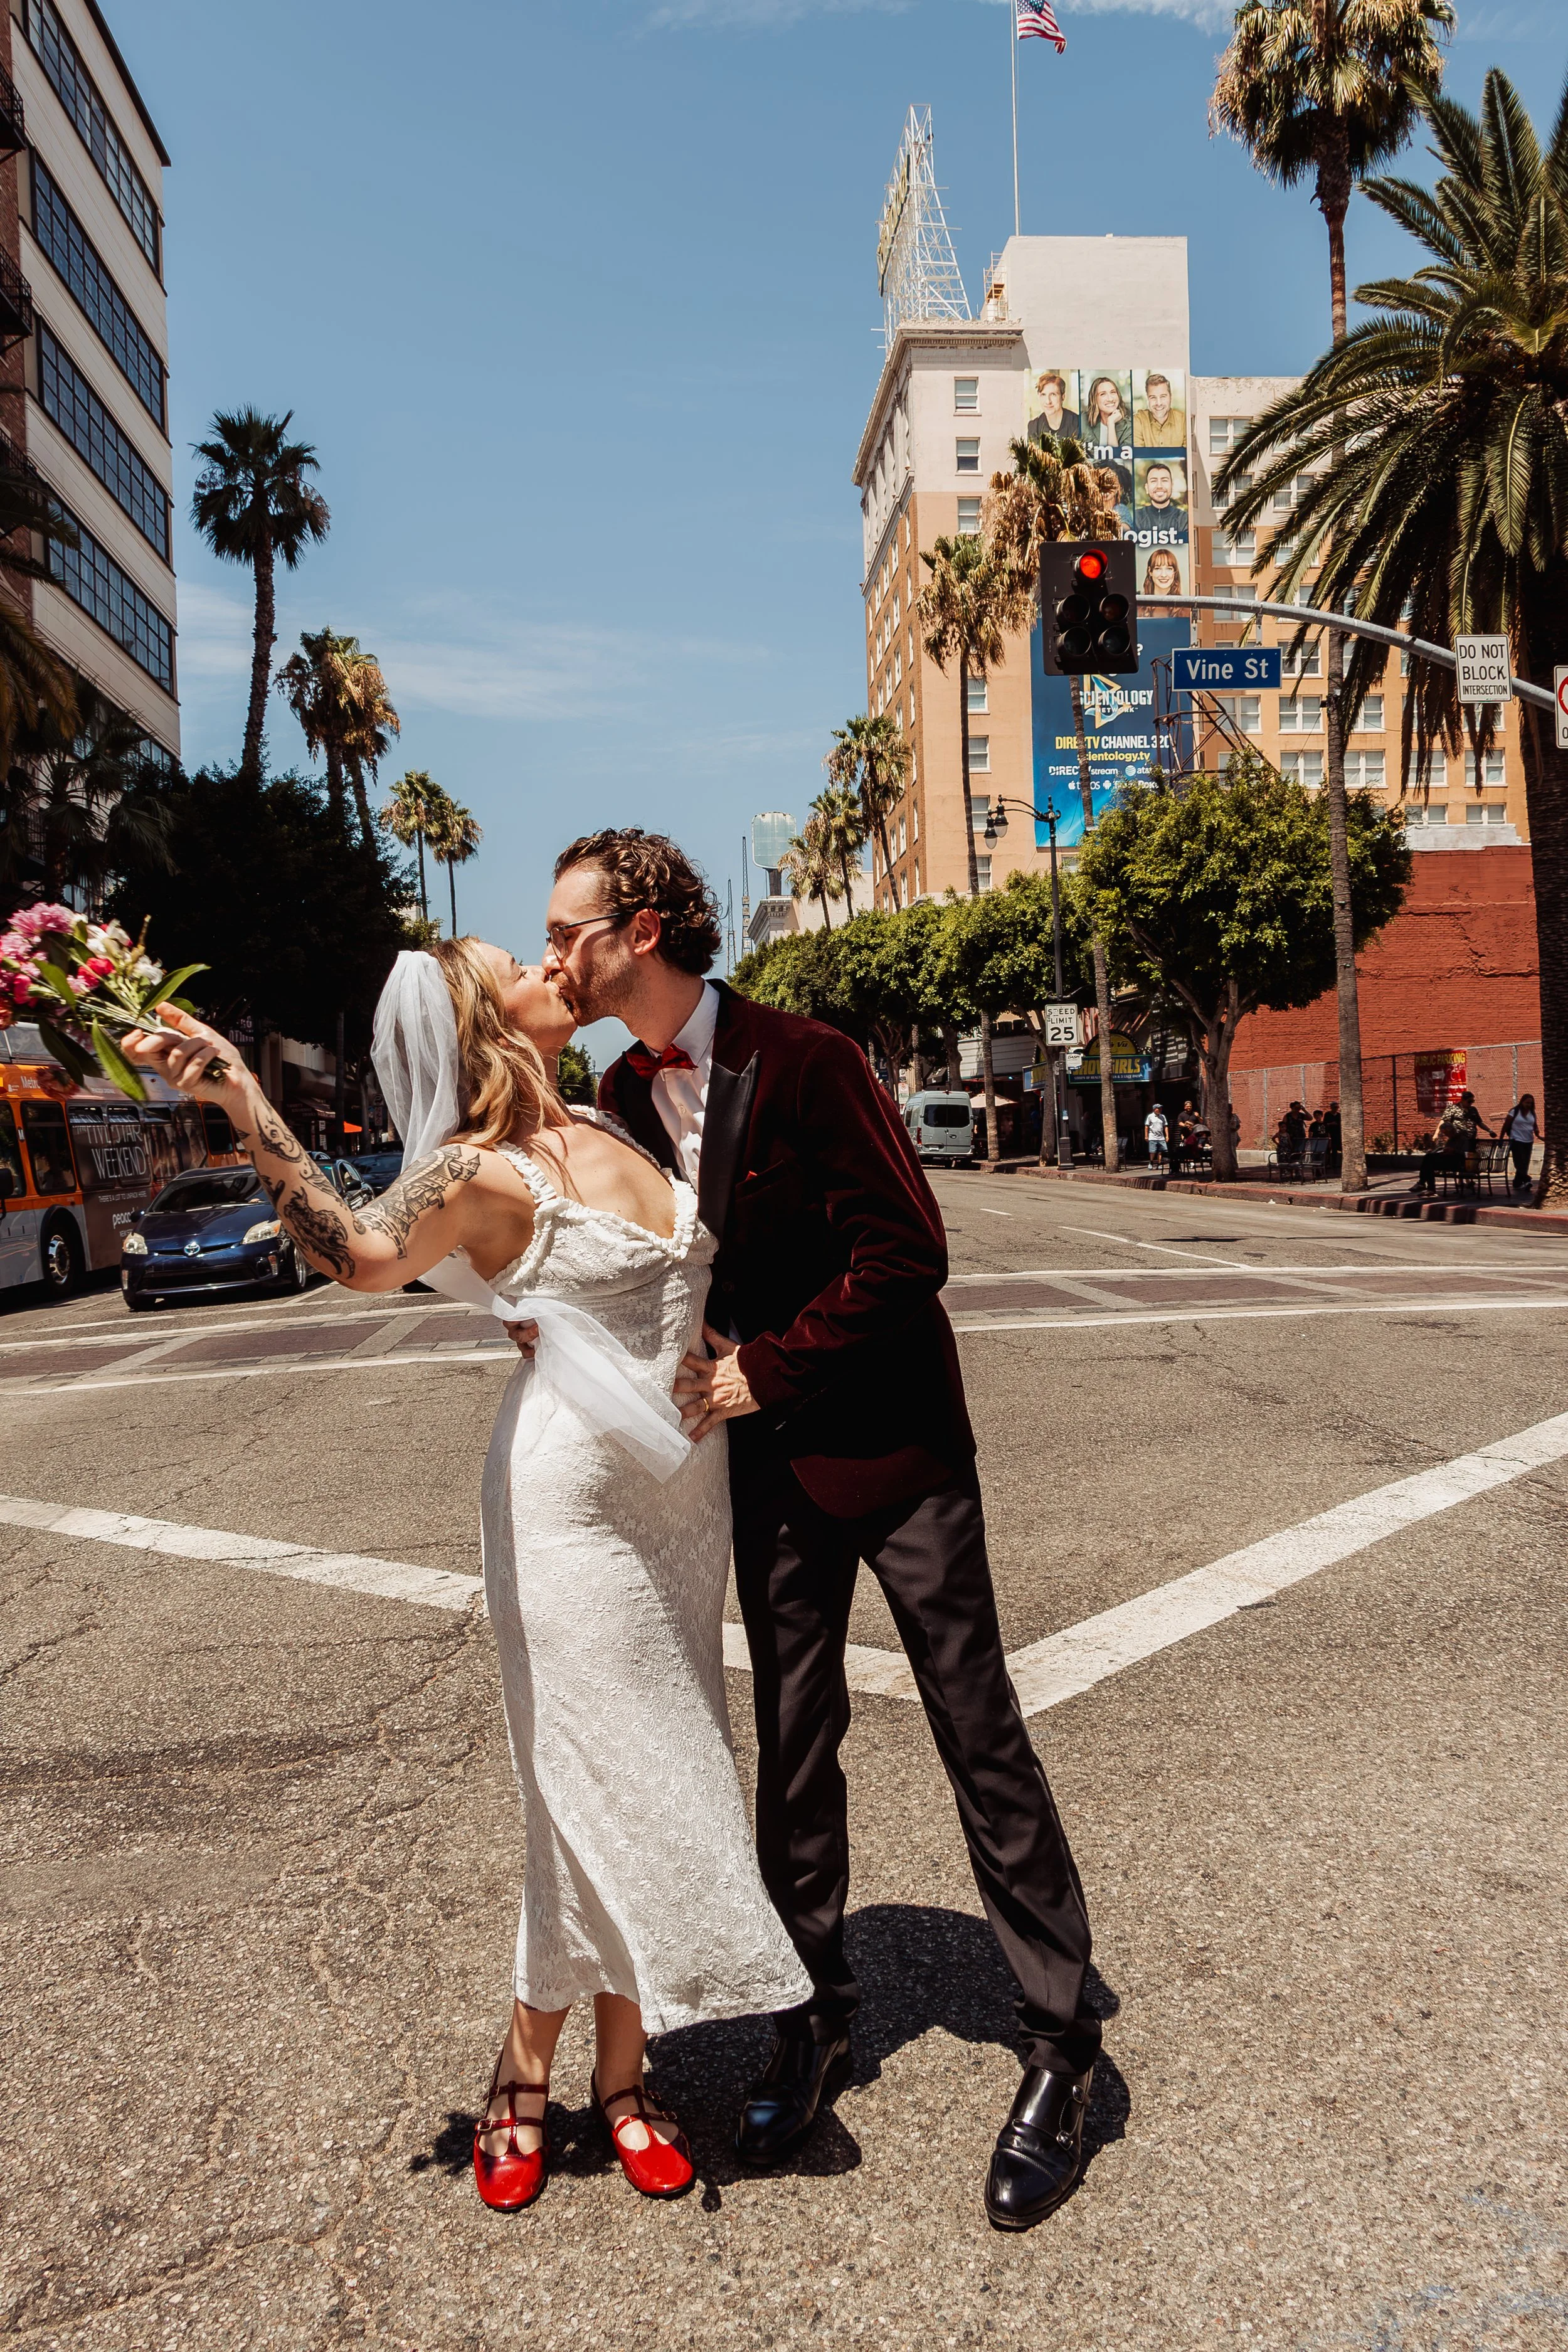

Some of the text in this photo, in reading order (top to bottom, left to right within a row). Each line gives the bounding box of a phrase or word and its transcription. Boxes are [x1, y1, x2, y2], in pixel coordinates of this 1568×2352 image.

[1120, 445, 1133, 460] a
[1459, 644, 1505, 659] DO NOT
[1187, 659, 1269, 680] Vine St
[1462, 665, 1507, 681] BLOCK
[1463, 685, 1508, 695] INTERSECTION
[1055, 736, 1100, 750] DIRETV
[1101, 735, 1150, 749] CHANNEL
[1077, 751, 1151, 762] ientology.tv
[1050, 1027, 1074, 1041] 25
[1437, 1052, 1466, 1065] PARKING
[91, 1147, 146, 1179] WEEKEND
